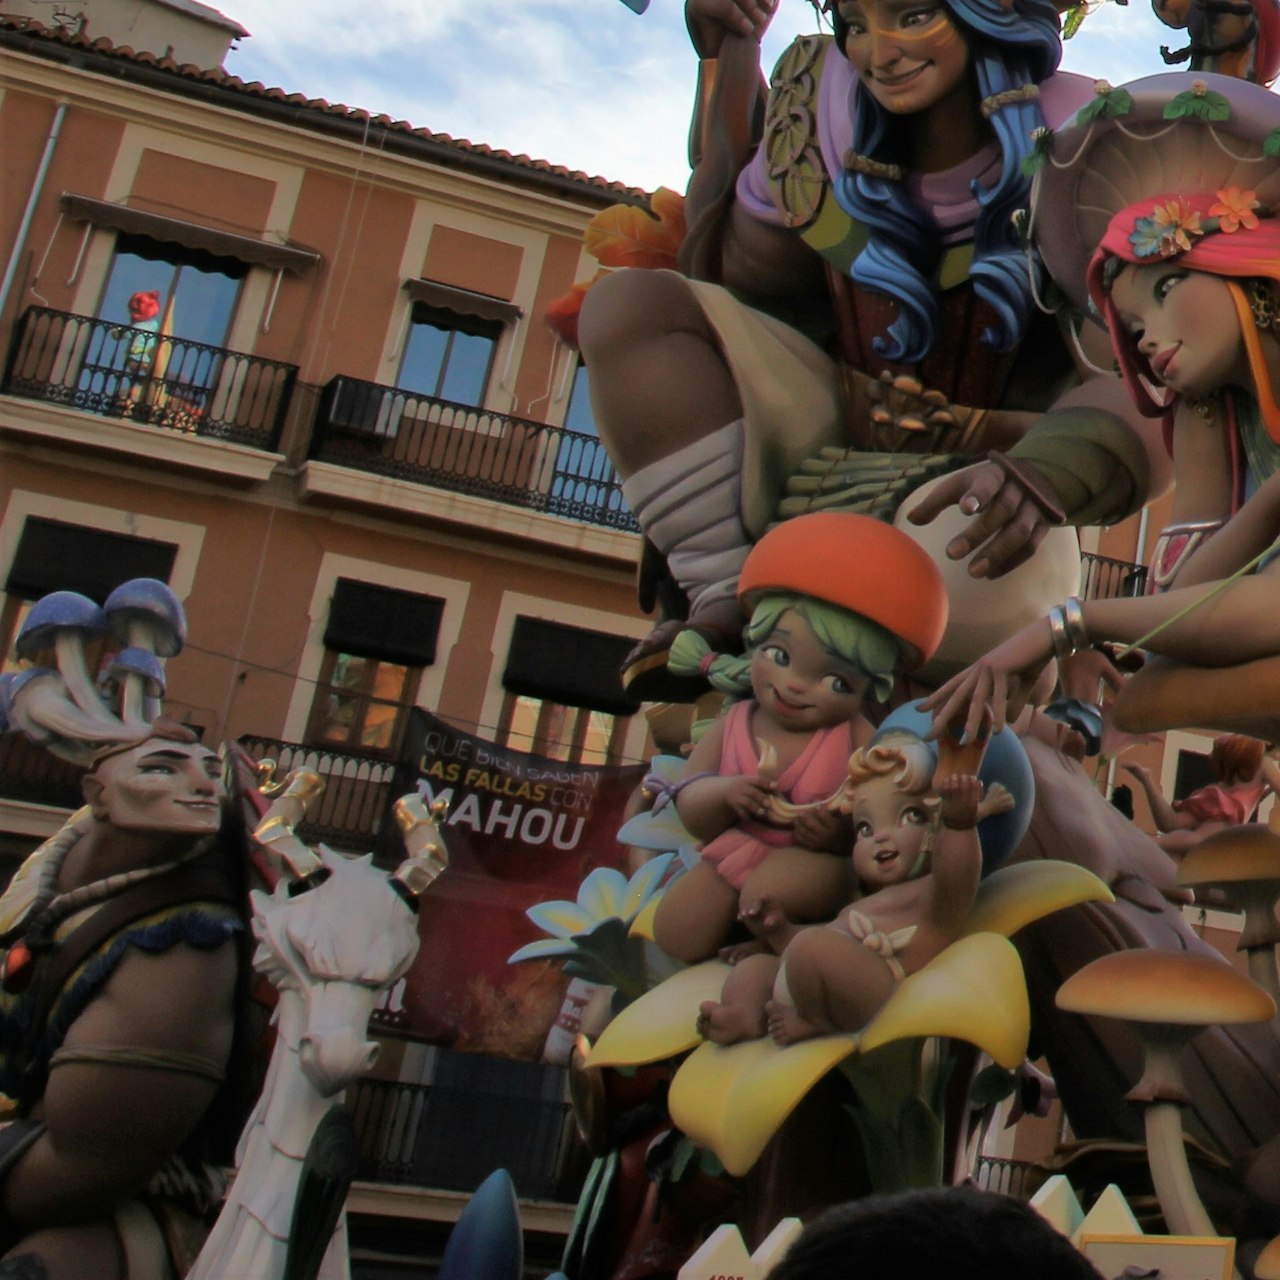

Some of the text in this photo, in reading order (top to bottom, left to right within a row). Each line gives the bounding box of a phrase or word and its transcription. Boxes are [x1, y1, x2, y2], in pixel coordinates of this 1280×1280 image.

[425, 732, 472, 760] QUE
[419, 755, 592, 811] LAS FALLAS CON
